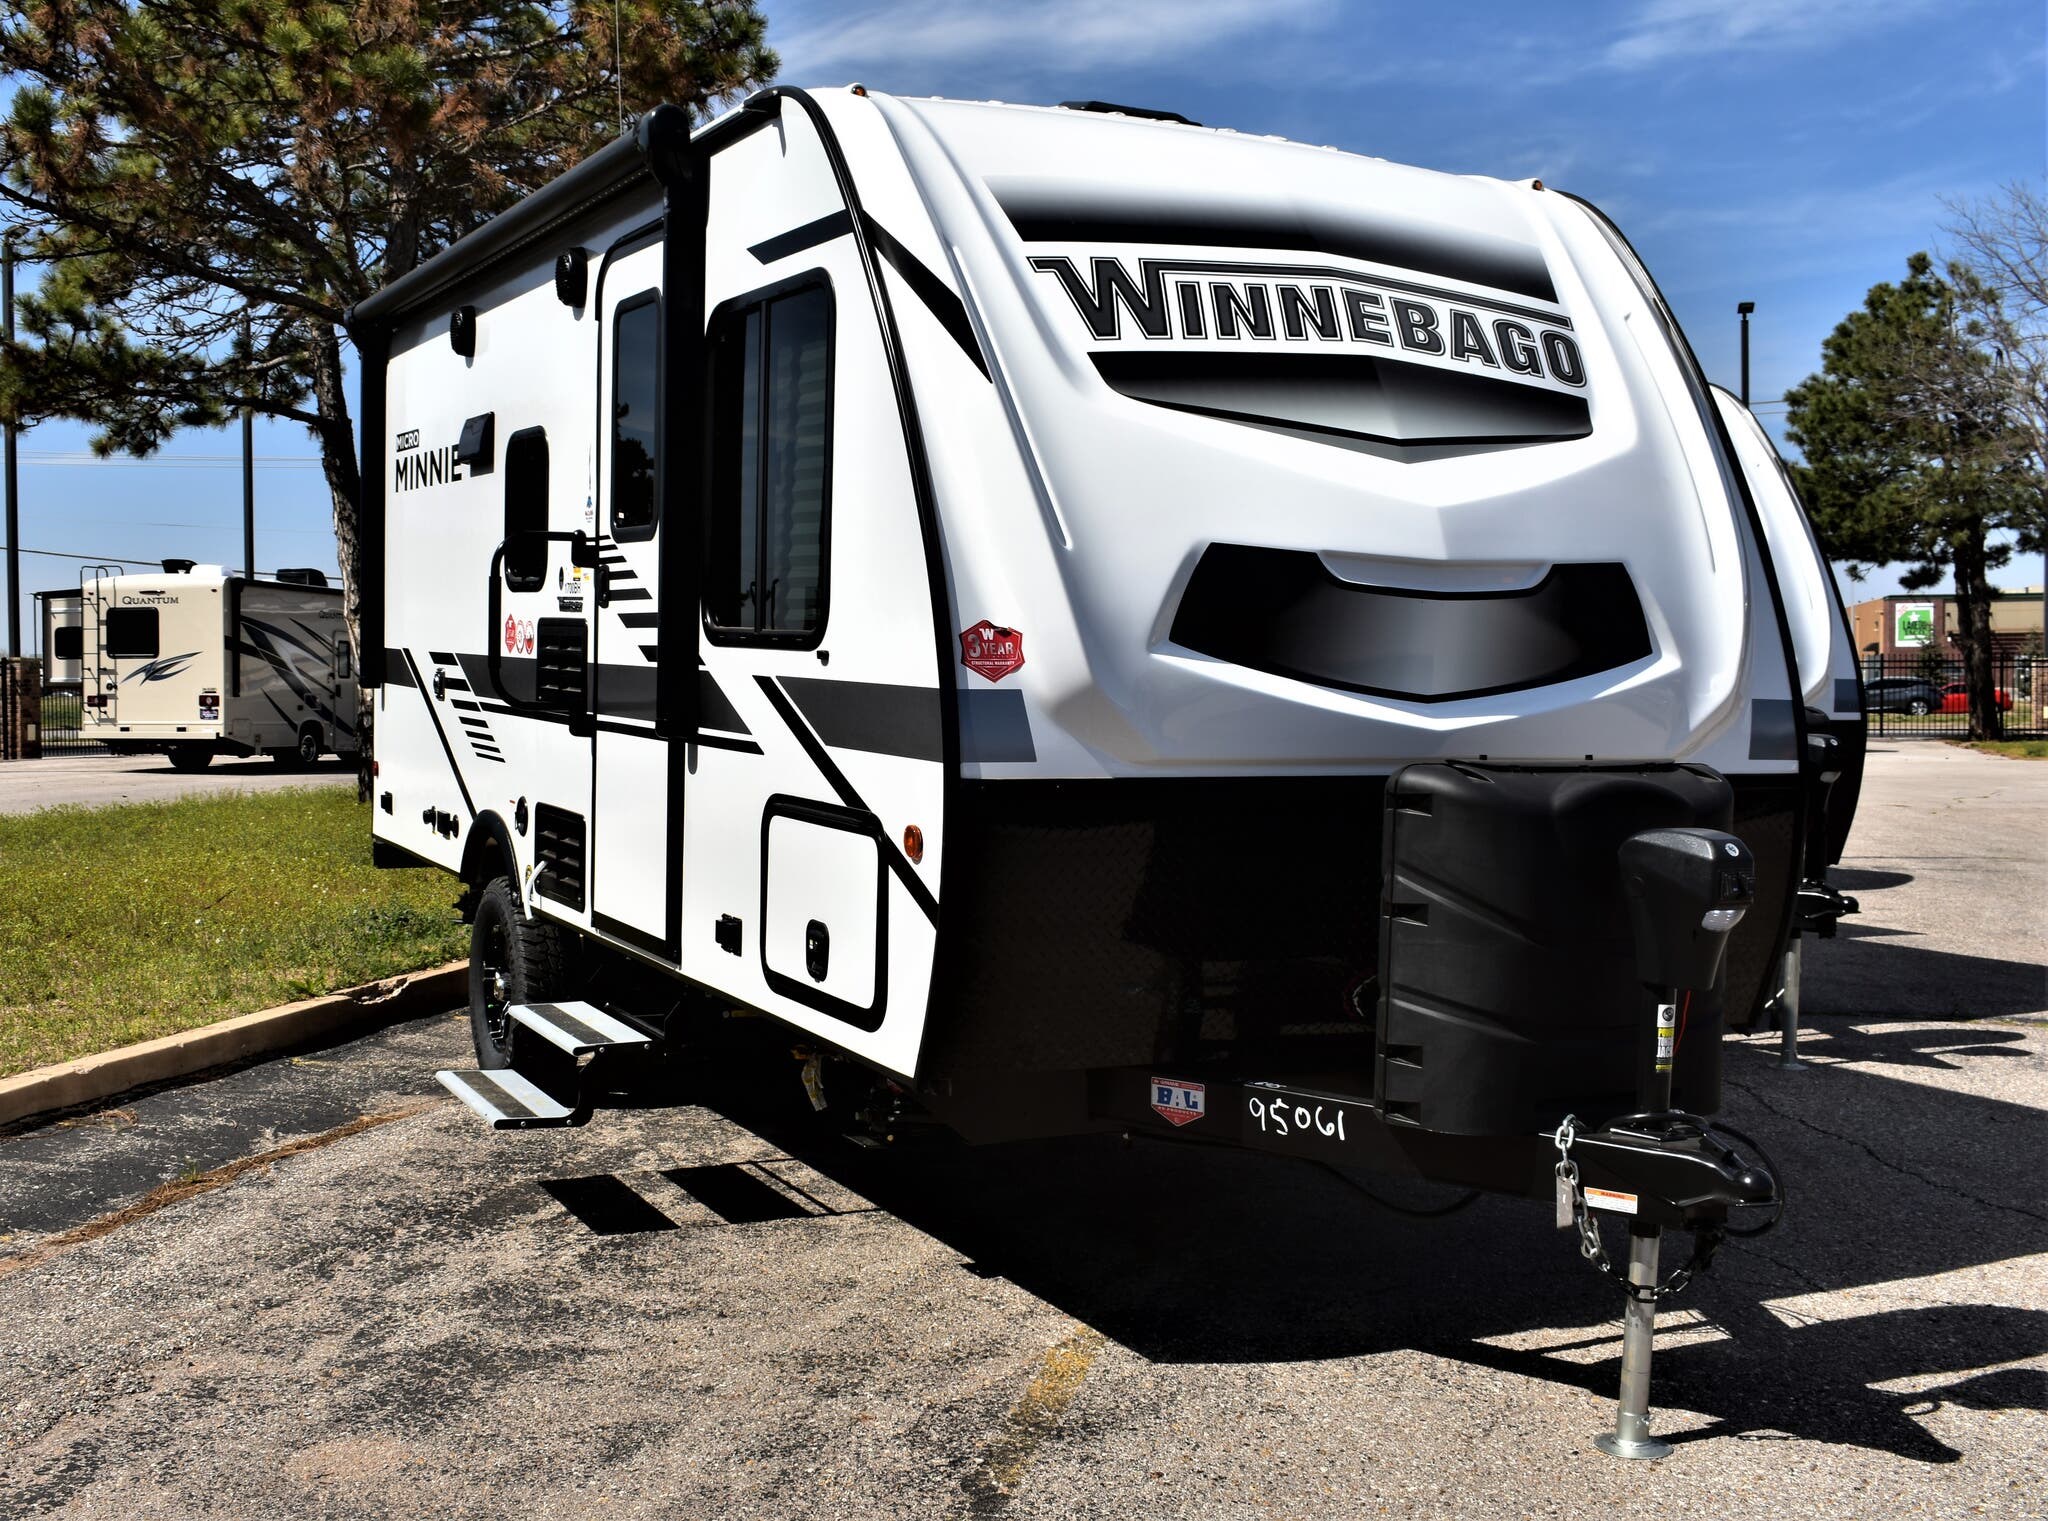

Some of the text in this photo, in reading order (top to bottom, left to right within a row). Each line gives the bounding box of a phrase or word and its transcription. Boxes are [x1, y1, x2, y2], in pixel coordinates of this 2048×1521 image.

[1026, 256, 1587, 388] WINNEBAGO
[397, 431, 419, 450] MICRO
[395, 443, 462, 493] MINNIE
[121, 596, 179, 605] QUANTUM
[967, 634, 1013, 658] 3 YEAR
[979, 628, 995, 640] W
[1249, 1097, 1346, 1141] 95061
